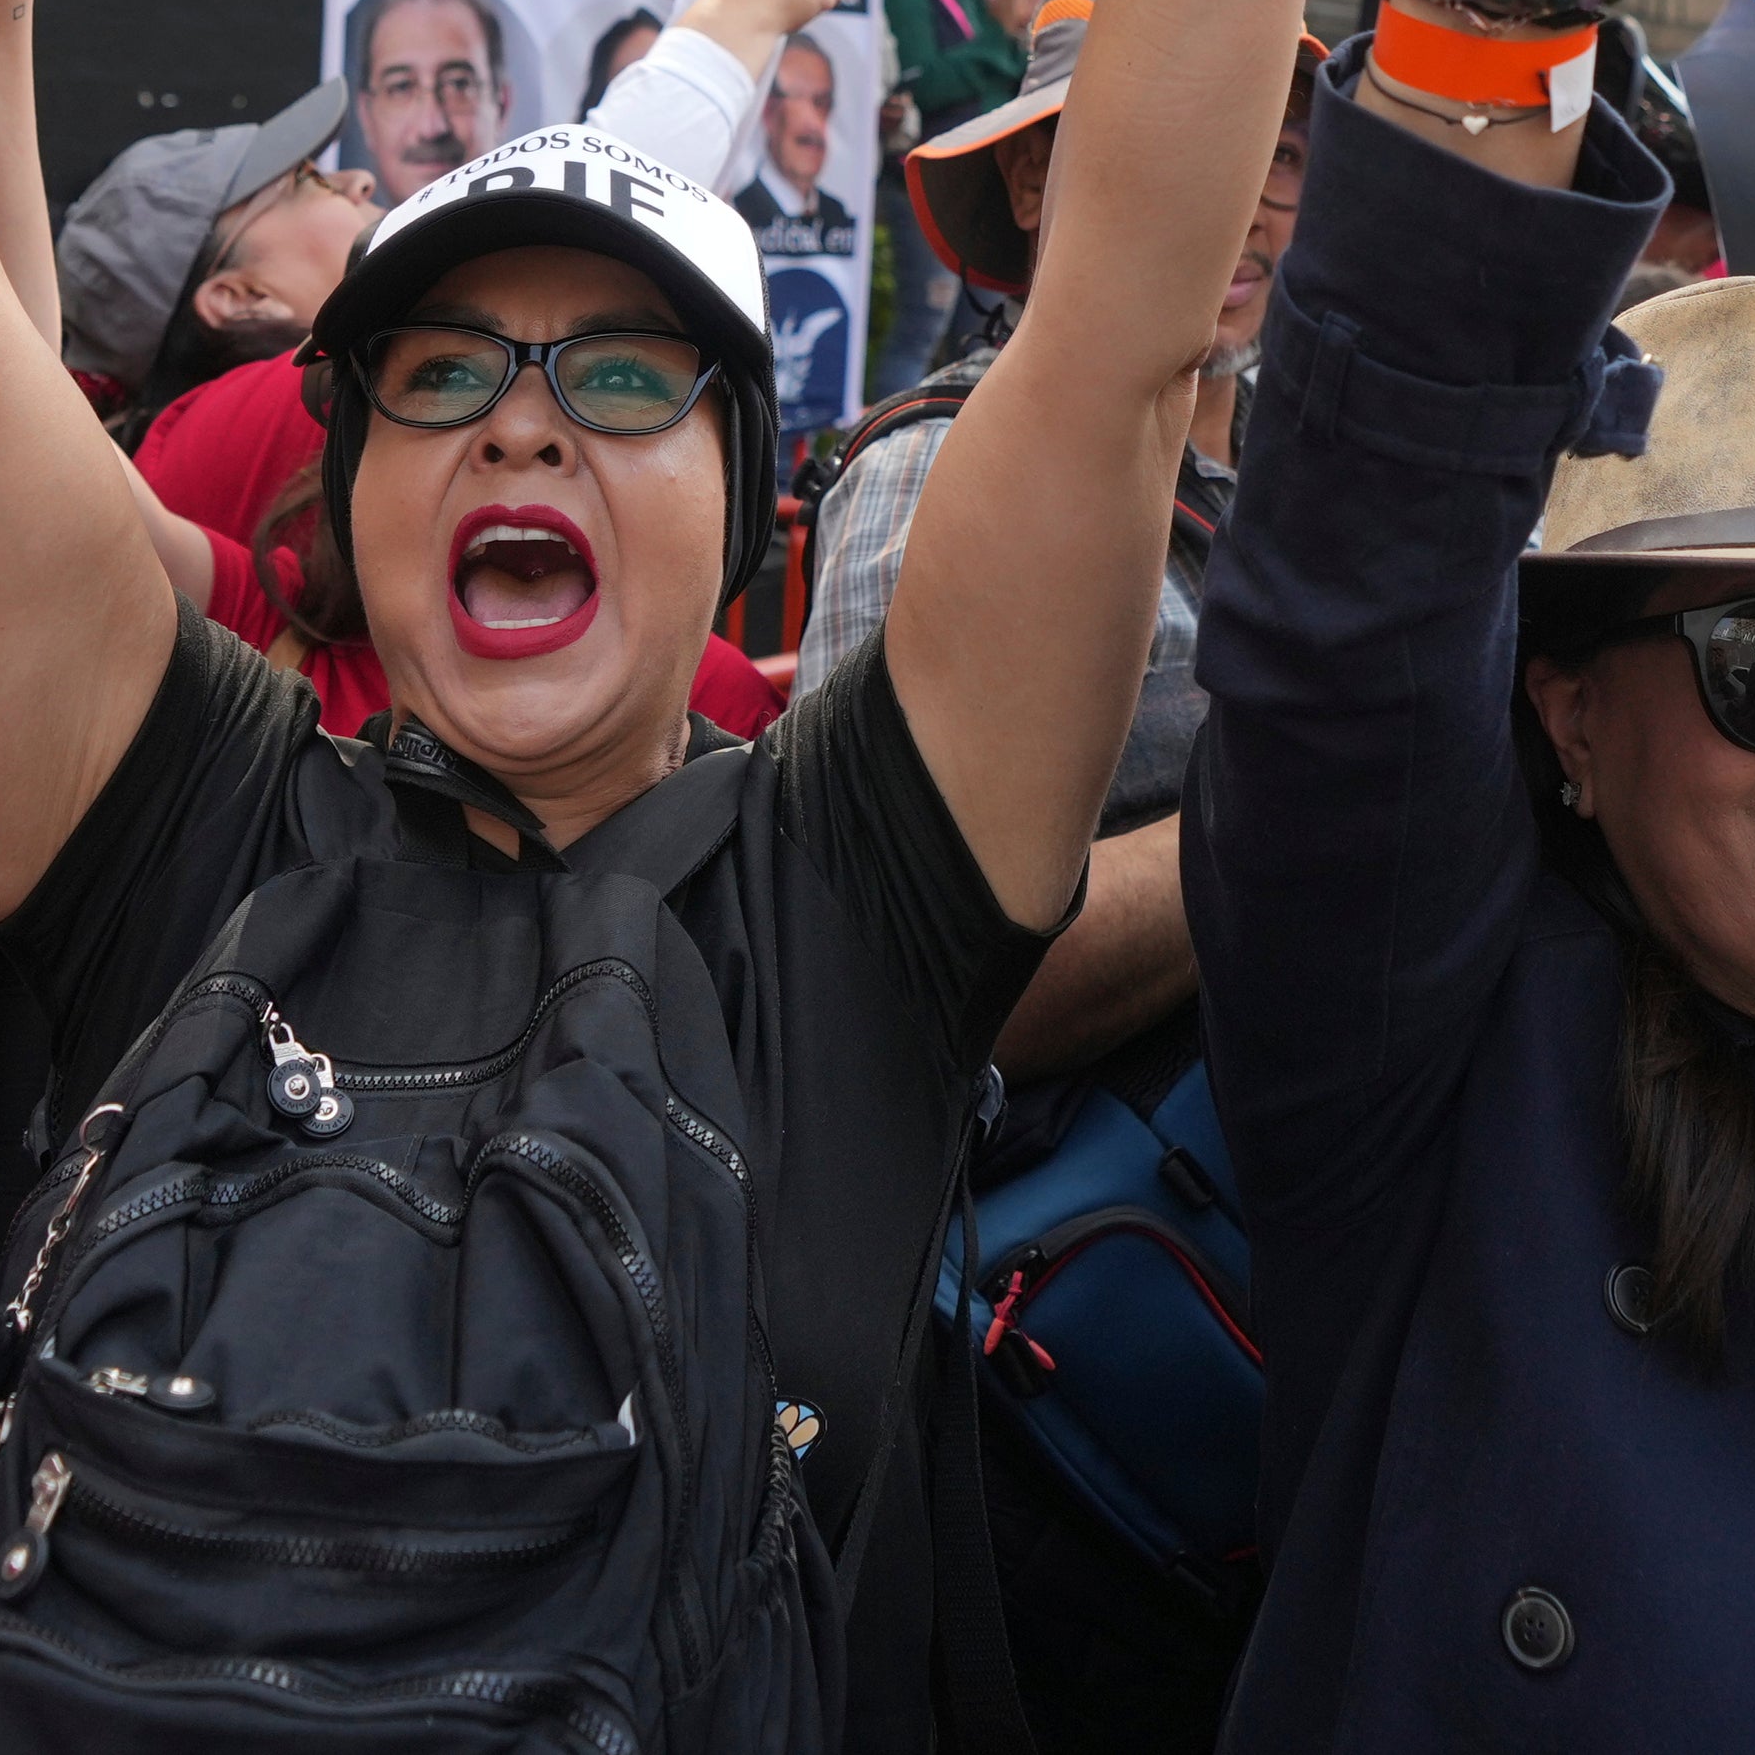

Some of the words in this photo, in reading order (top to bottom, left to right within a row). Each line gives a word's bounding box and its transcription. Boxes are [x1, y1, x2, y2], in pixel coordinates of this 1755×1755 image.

[444, 132, 571, 187] TODOS
[582, 135, 709, 204] SOMOS
[274, 1063, 313, 1083] KIPLING
